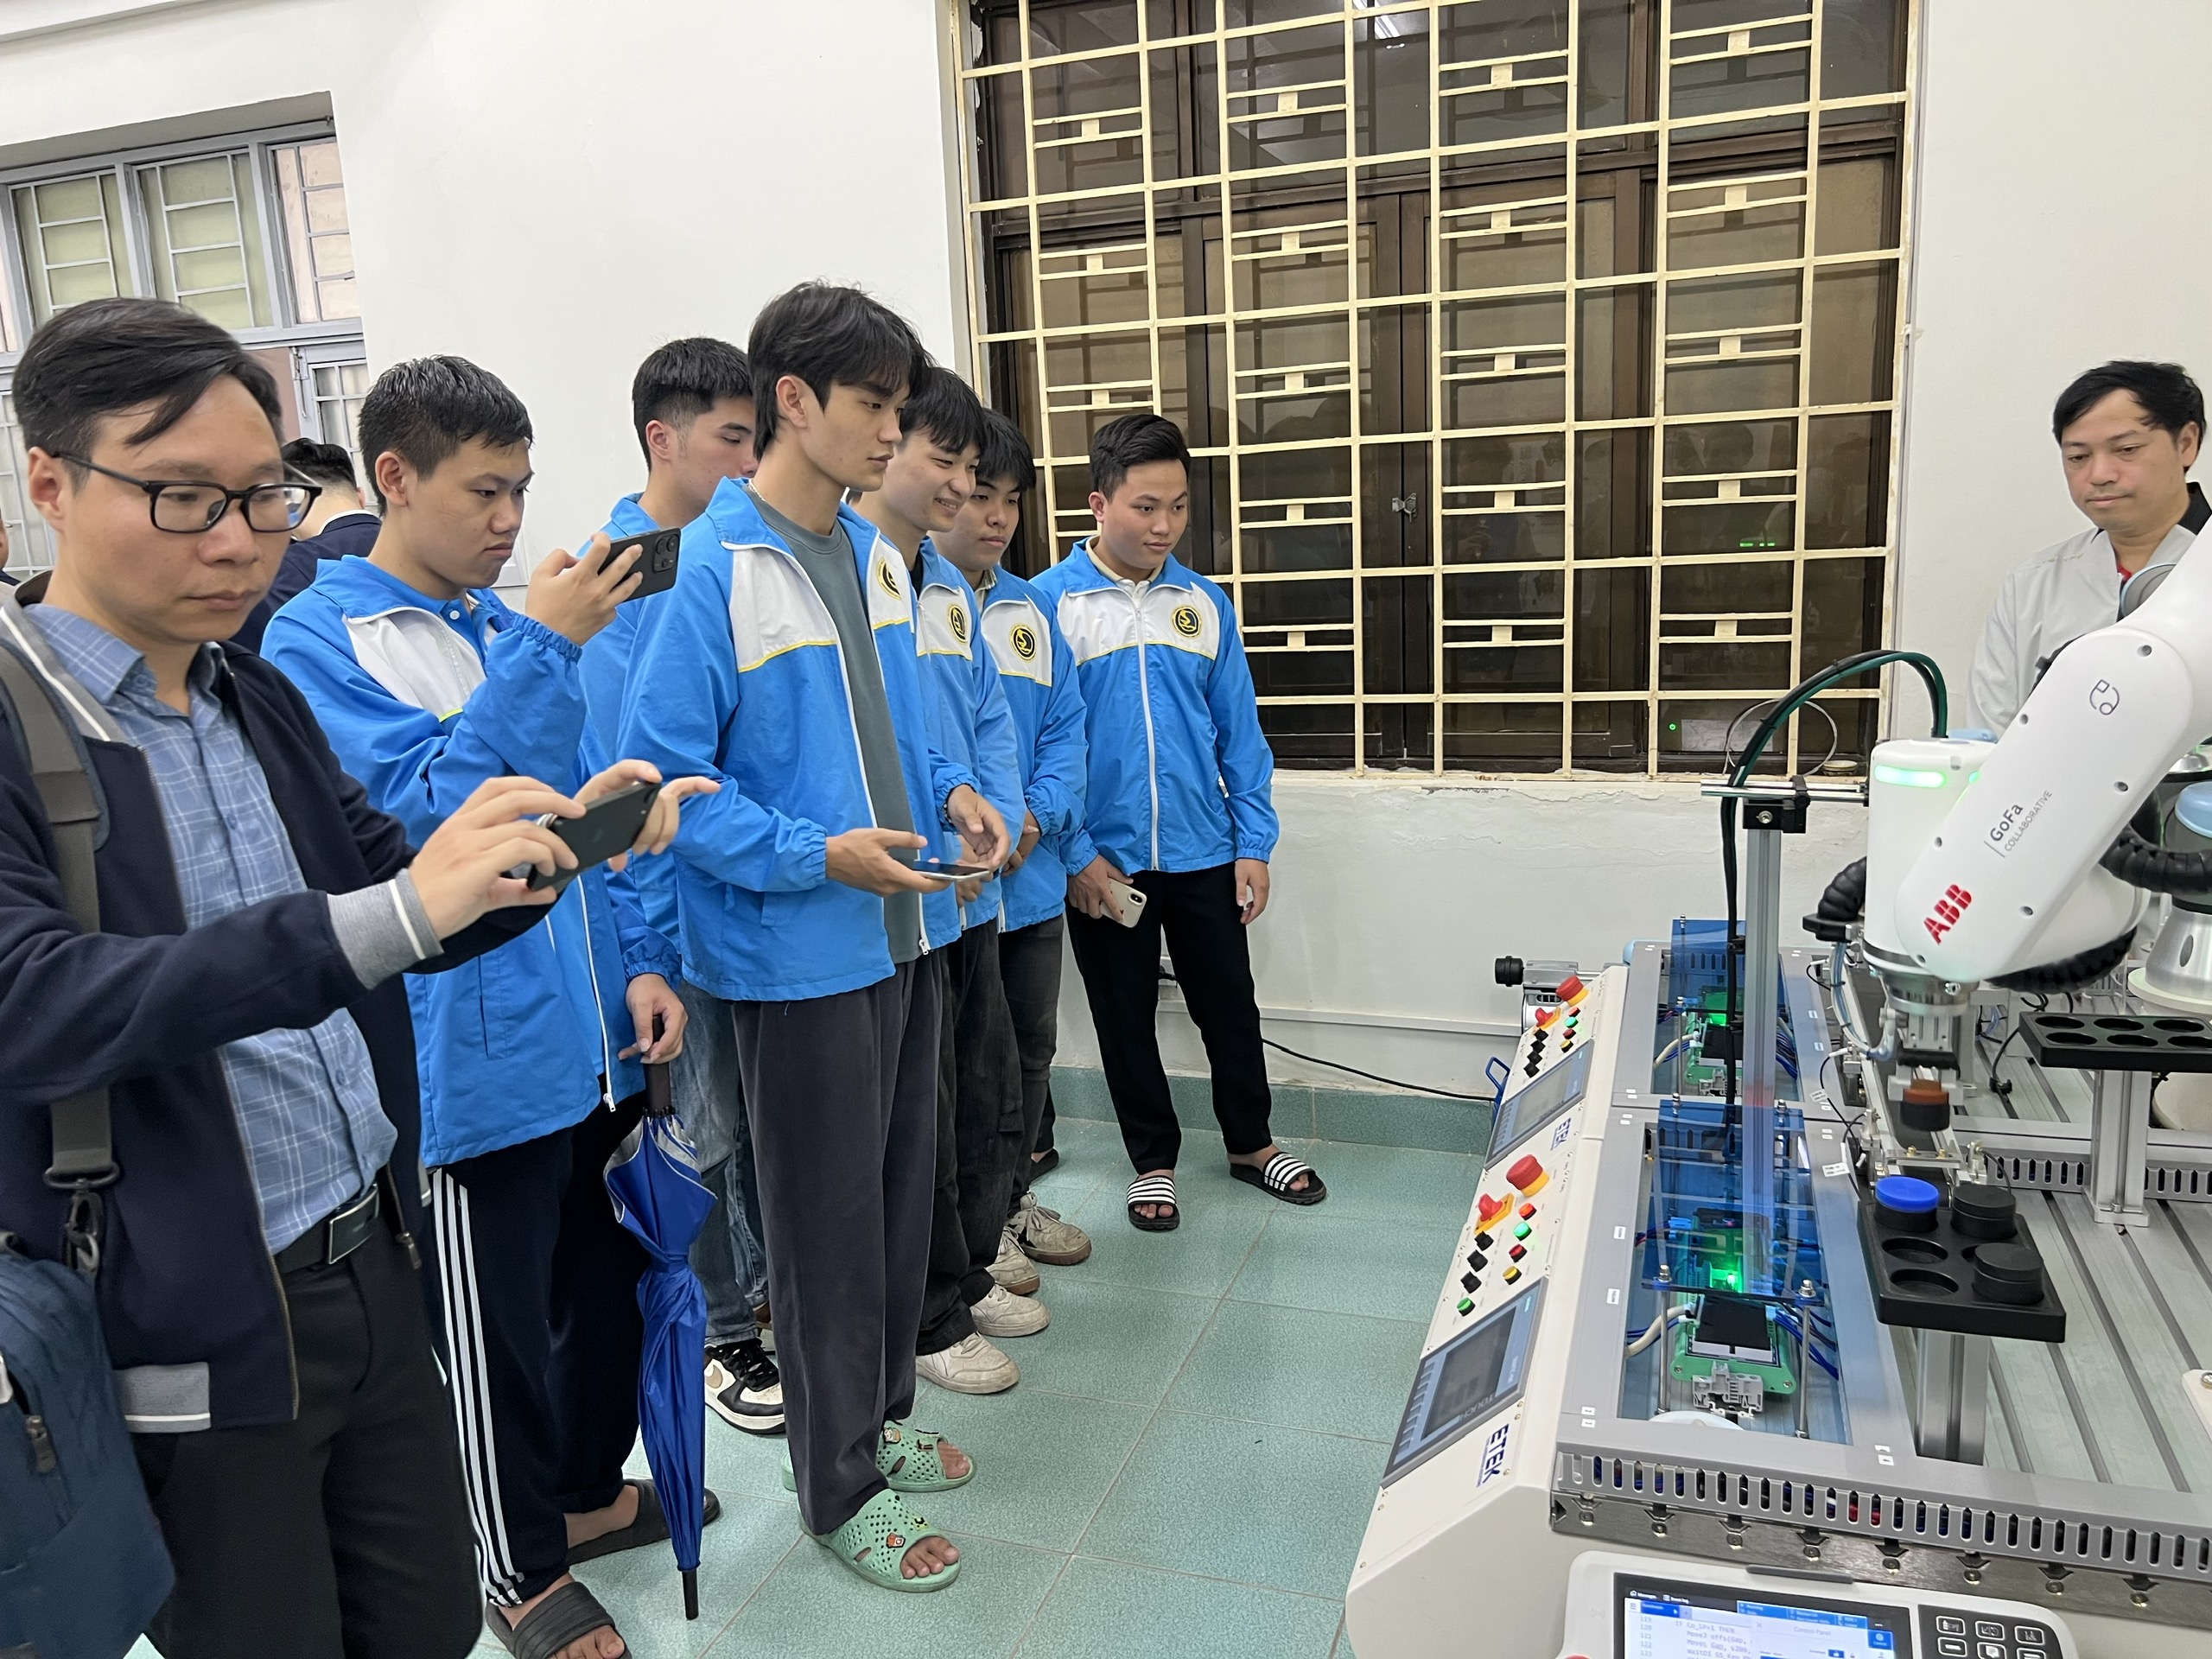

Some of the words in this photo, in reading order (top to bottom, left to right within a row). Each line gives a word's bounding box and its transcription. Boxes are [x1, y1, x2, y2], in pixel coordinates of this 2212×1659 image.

[1990, 804, 2024, 842] GoFa
[2004, 790, 2052, 852] COLLABORATIVE
[1923, 884, 1972, 945] ABB
[1554, 1117, 1572, 1149] ETEK
[1483, 1423, 1510, 1484] ETEK
